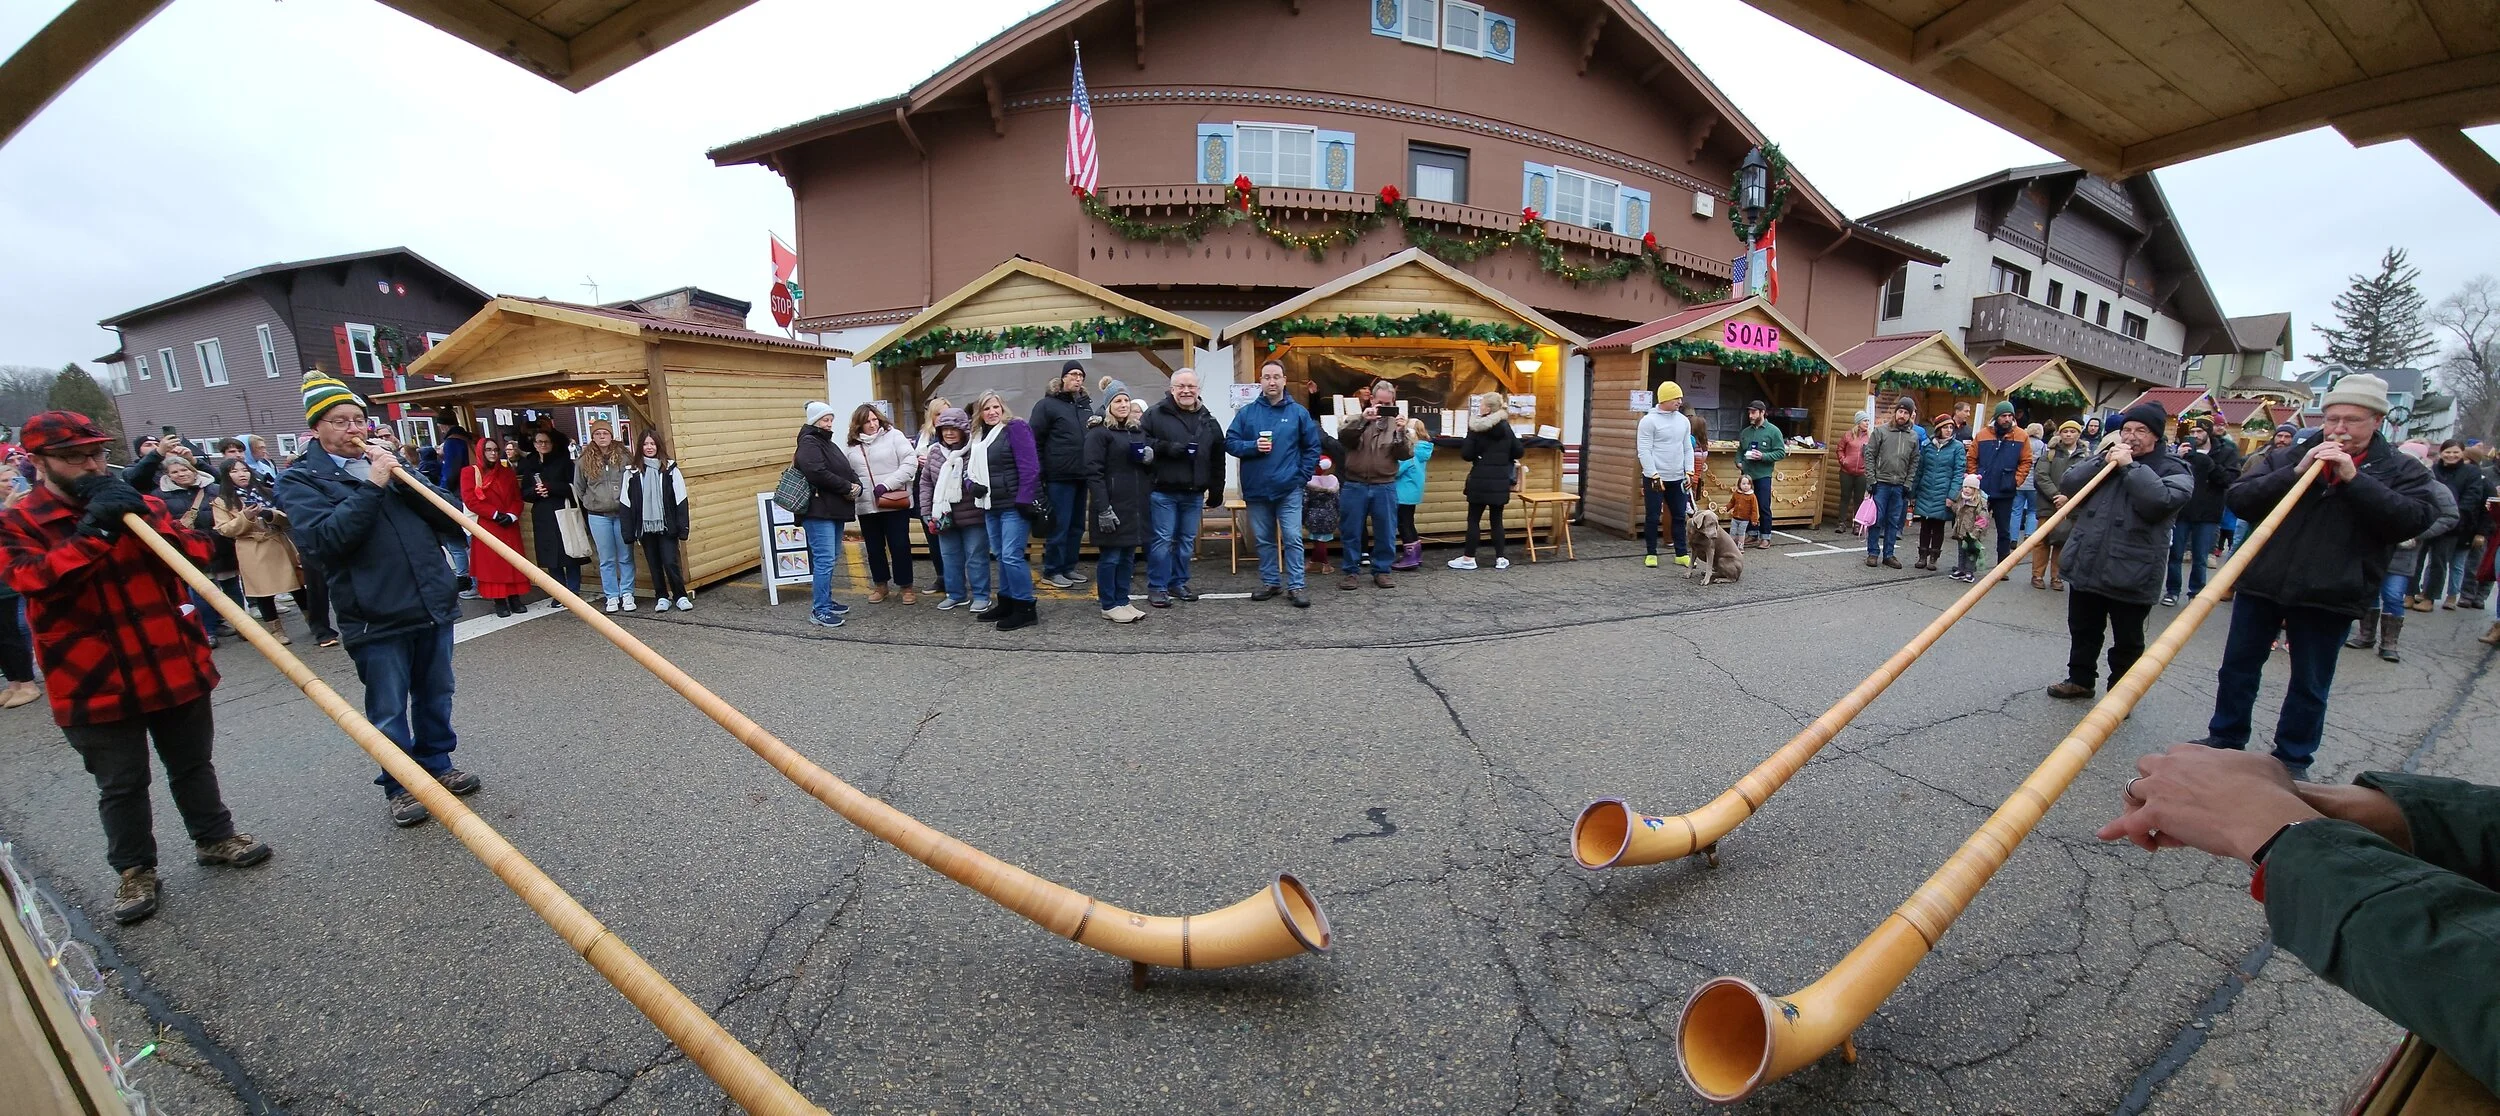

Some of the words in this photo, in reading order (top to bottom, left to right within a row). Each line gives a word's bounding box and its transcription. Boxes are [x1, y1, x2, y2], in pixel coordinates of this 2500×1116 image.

[771, 294, 792, 315] STOP
[1726, 322, 1778, 348] SOAP
[965, 350, 1015, 364] Shepherd
[1020, 349, 1030, 359] of
[1036, 347, 1052, 357] the
[1241, 388, 1250, 397] 16
